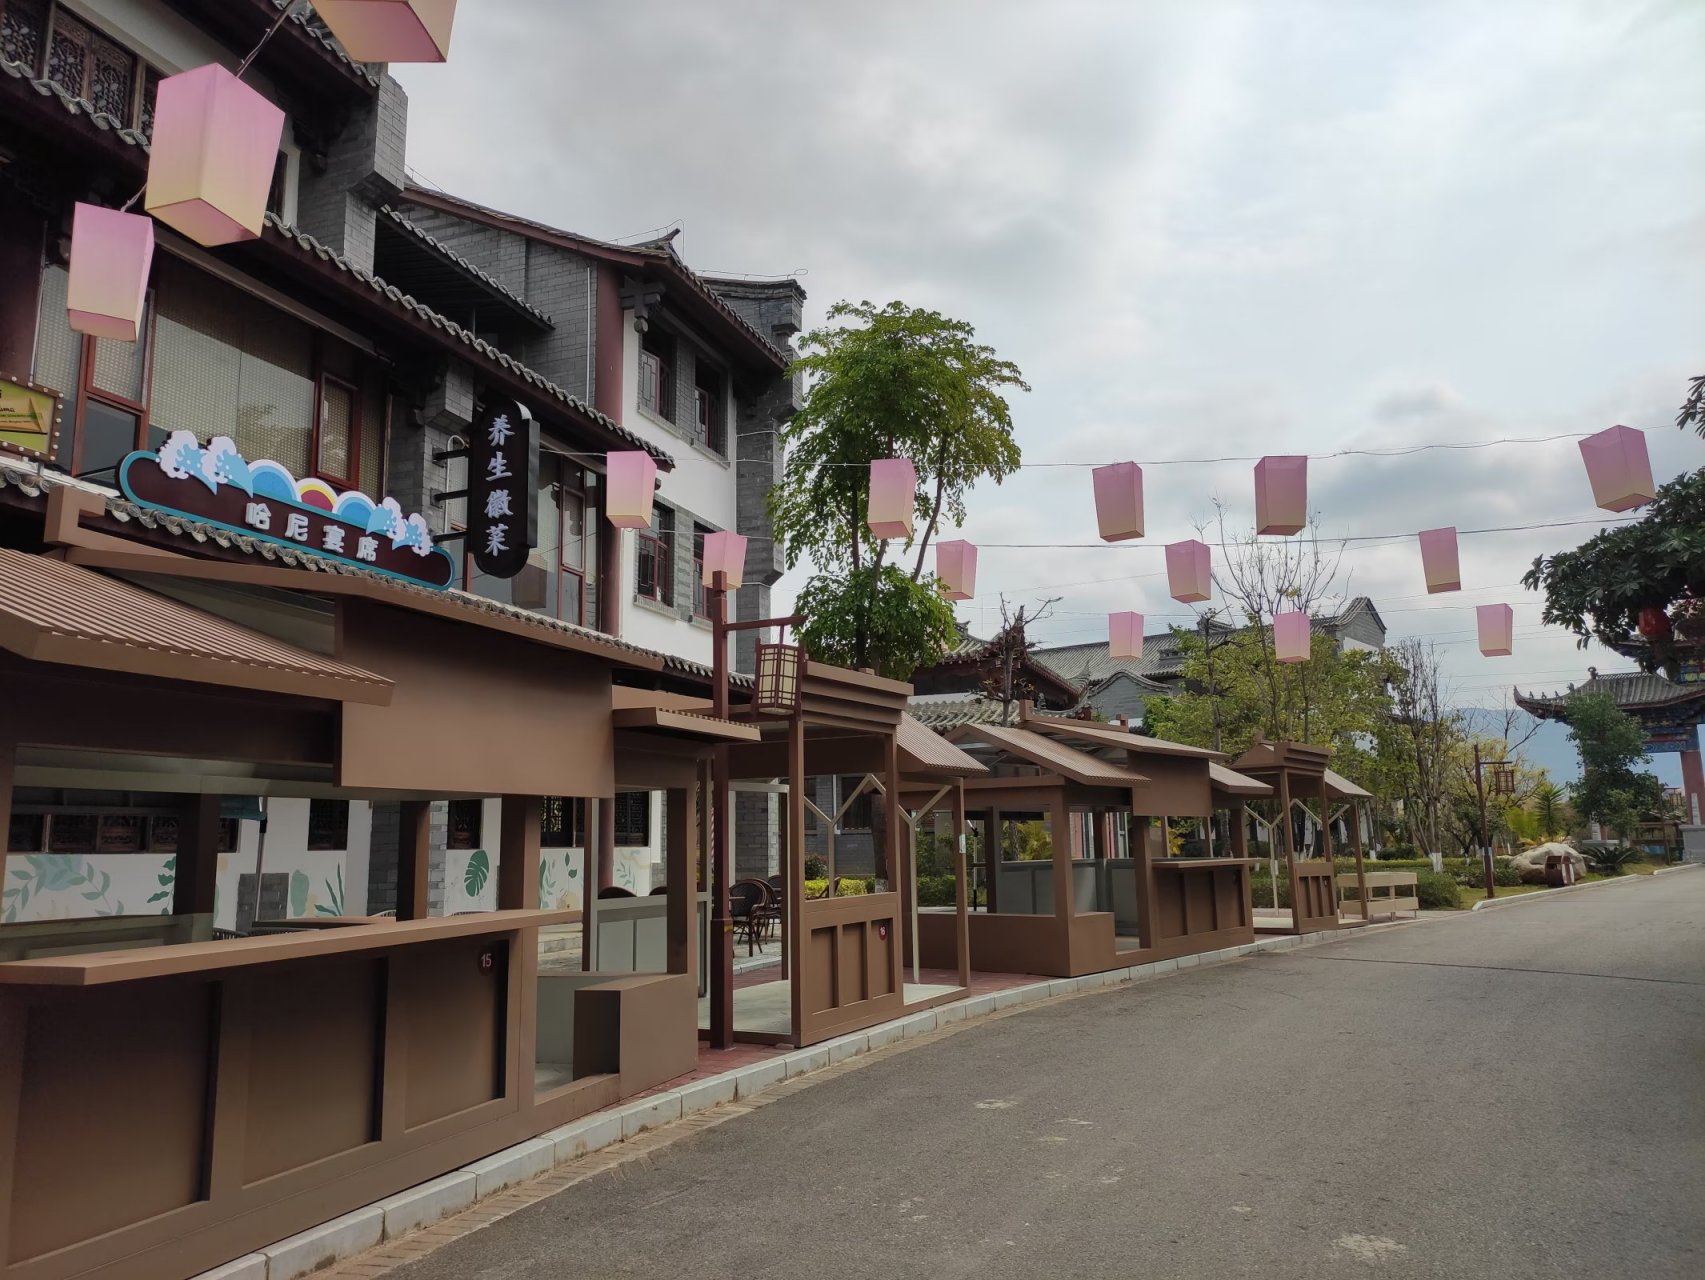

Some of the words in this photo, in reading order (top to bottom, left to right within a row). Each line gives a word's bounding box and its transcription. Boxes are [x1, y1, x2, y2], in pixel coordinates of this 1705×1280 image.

[484, 414, 515, 557] 养生徽菜
[245, 502, 379, 562] 哈尼宴席
[480, 953, 492, 968] 15
